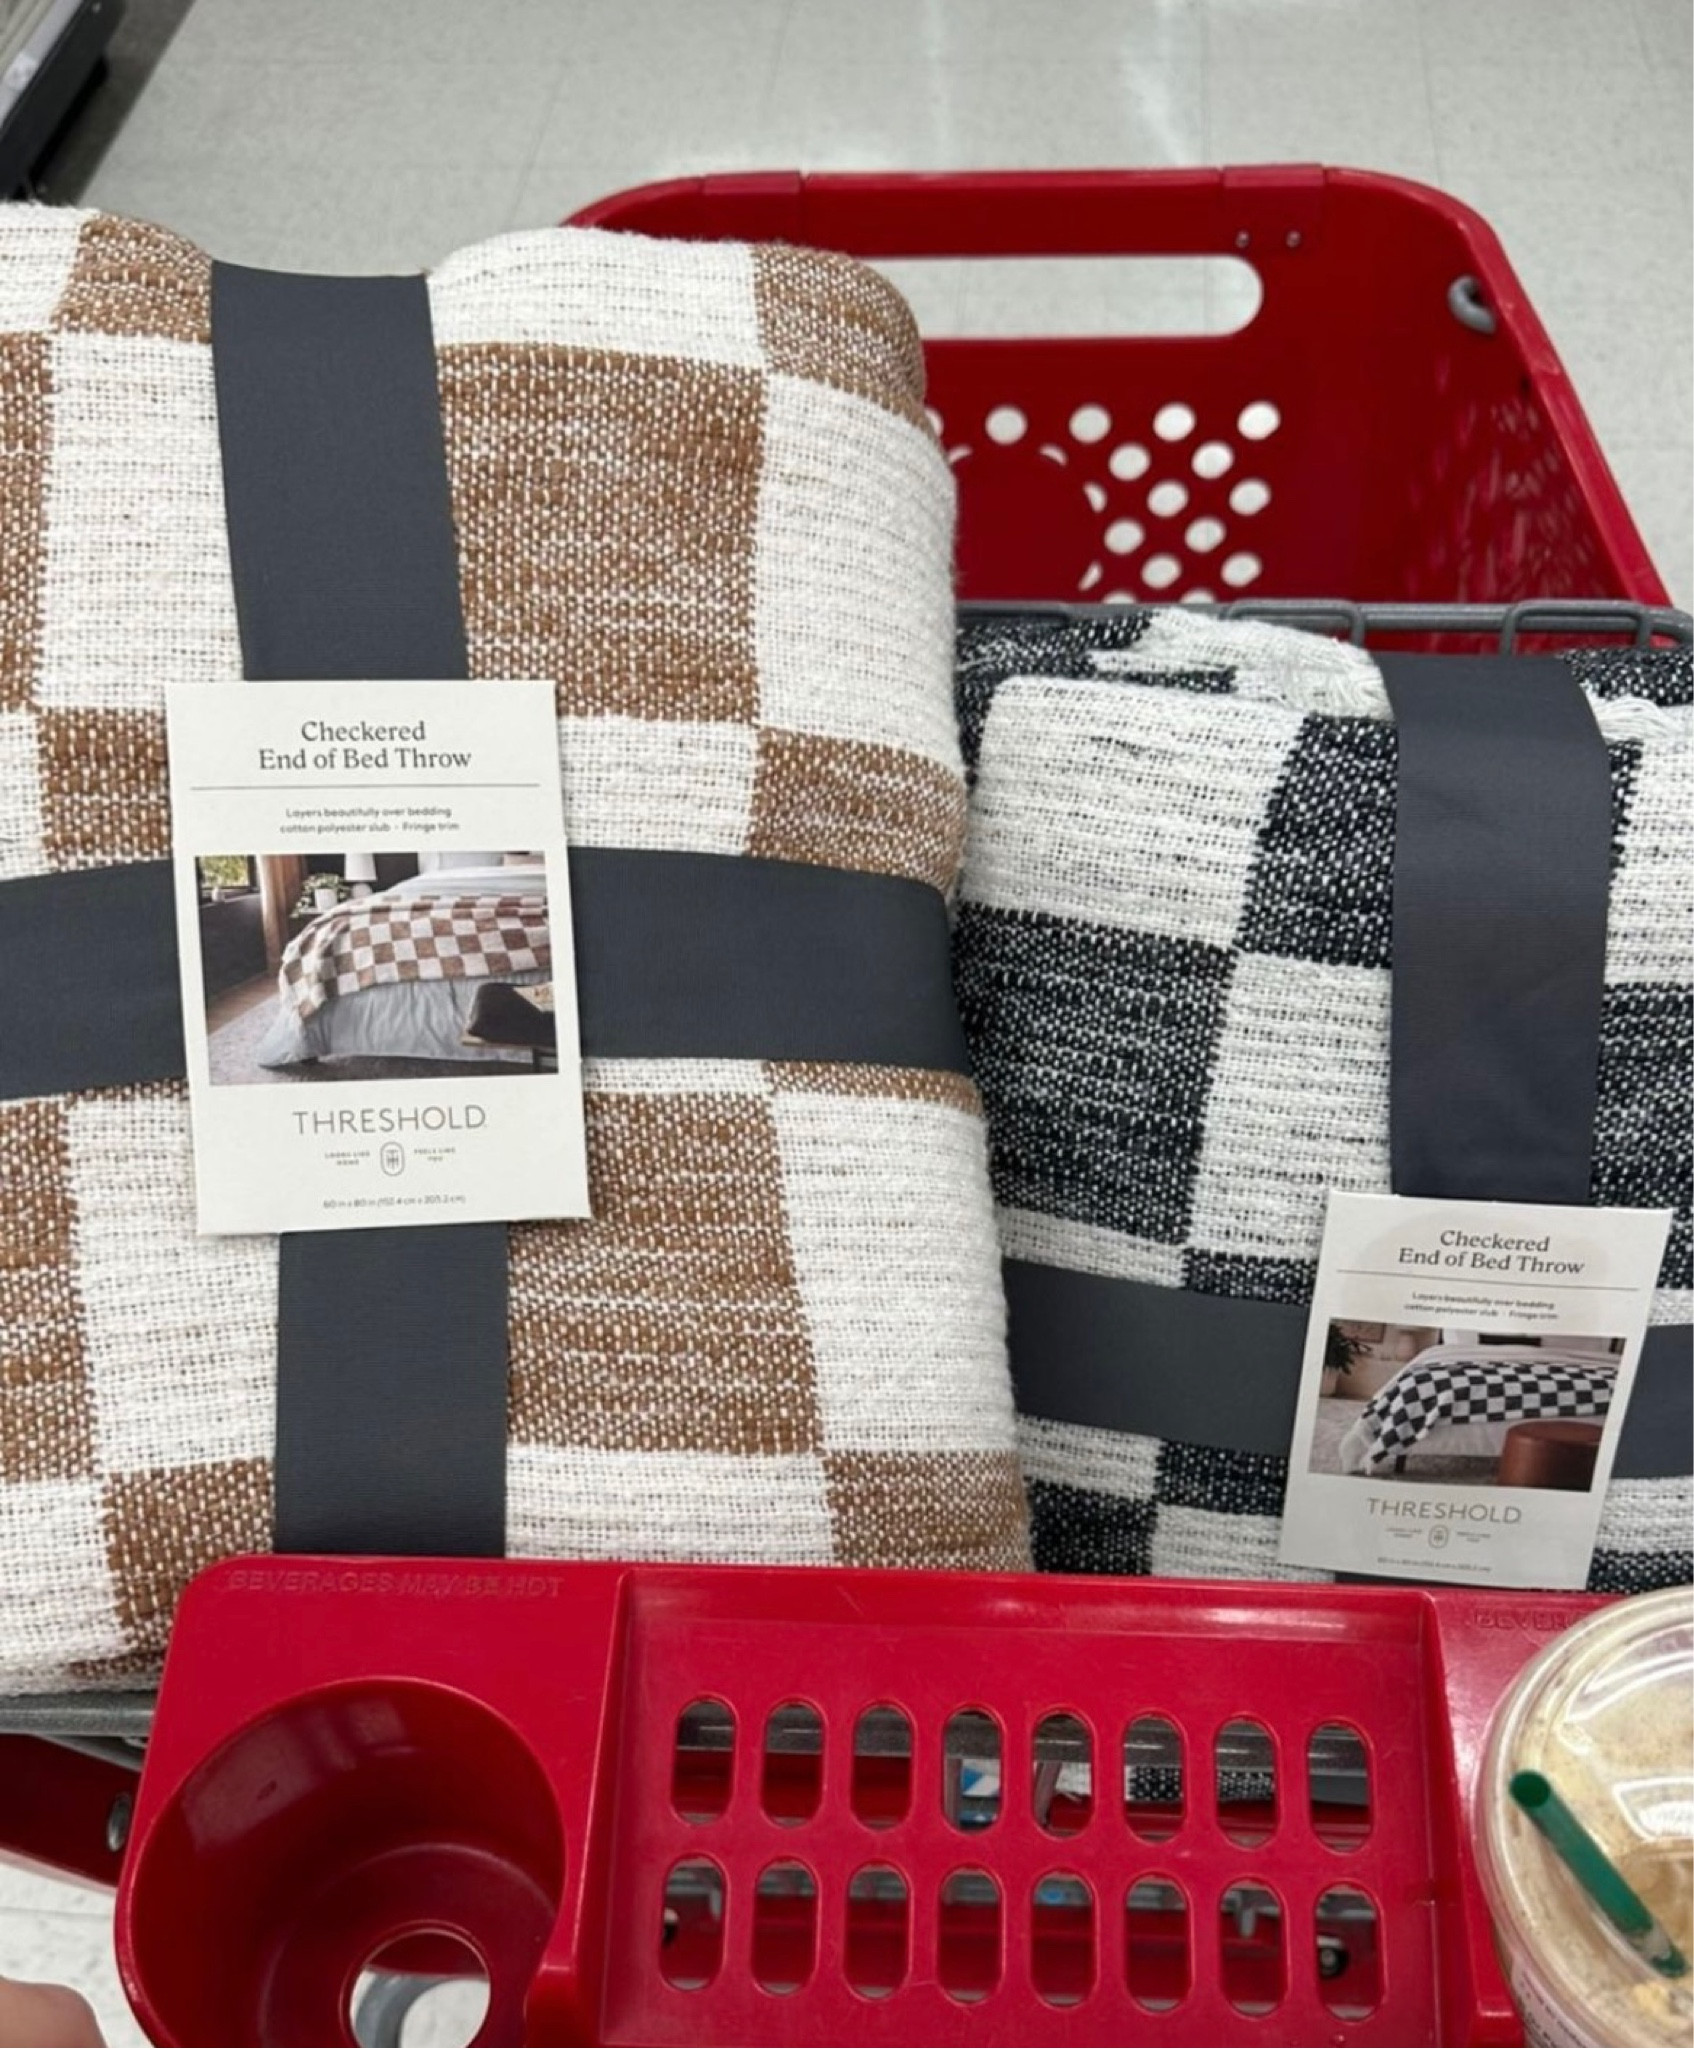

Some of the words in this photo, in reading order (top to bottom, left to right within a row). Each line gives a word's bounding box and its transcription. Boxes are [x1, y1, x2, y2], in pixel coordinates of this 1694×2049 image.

[301, 720, 427, 743] Checkered
[258, 748, 307, 771] End
[313, 748, 338, 770] of
[343, 747, 389, 770] Bed
[394, 747, 473, 769] Throw
[285, 807, 322, 819] Layers
[323, 807, 380, 819] beautifully
[381, 809, 405, 818] over
[407, 807, 453, 819] bedding
[279, 824, 316, 834] cotton
[317, 823, 367, 835] polyester
[368, 823, 392, 833] slub
[401, 821, 437, 834] Fringe
[438, 822, 460, 831] trim
[292, 1104, 487, 1135] THRESHOLD
[1439, 1229, 1551, 1253] Checkered
[1398, 1247, 1440, 1266] End
[1445, 1250, 1466, 1268] of
[1470, 1251, 1511, 1272] Bed
[1516, 1254, 1585, 1276] Throw
[1366, 1497, 1523, 1525] THRESHOLD
[226, 1569, 396, 1593] BEVERAGES
[397, 1572, 460, 1597] MAY
[463, 1574, 501, 1596] BE
[506, 1575, 566, 1598] HOT
